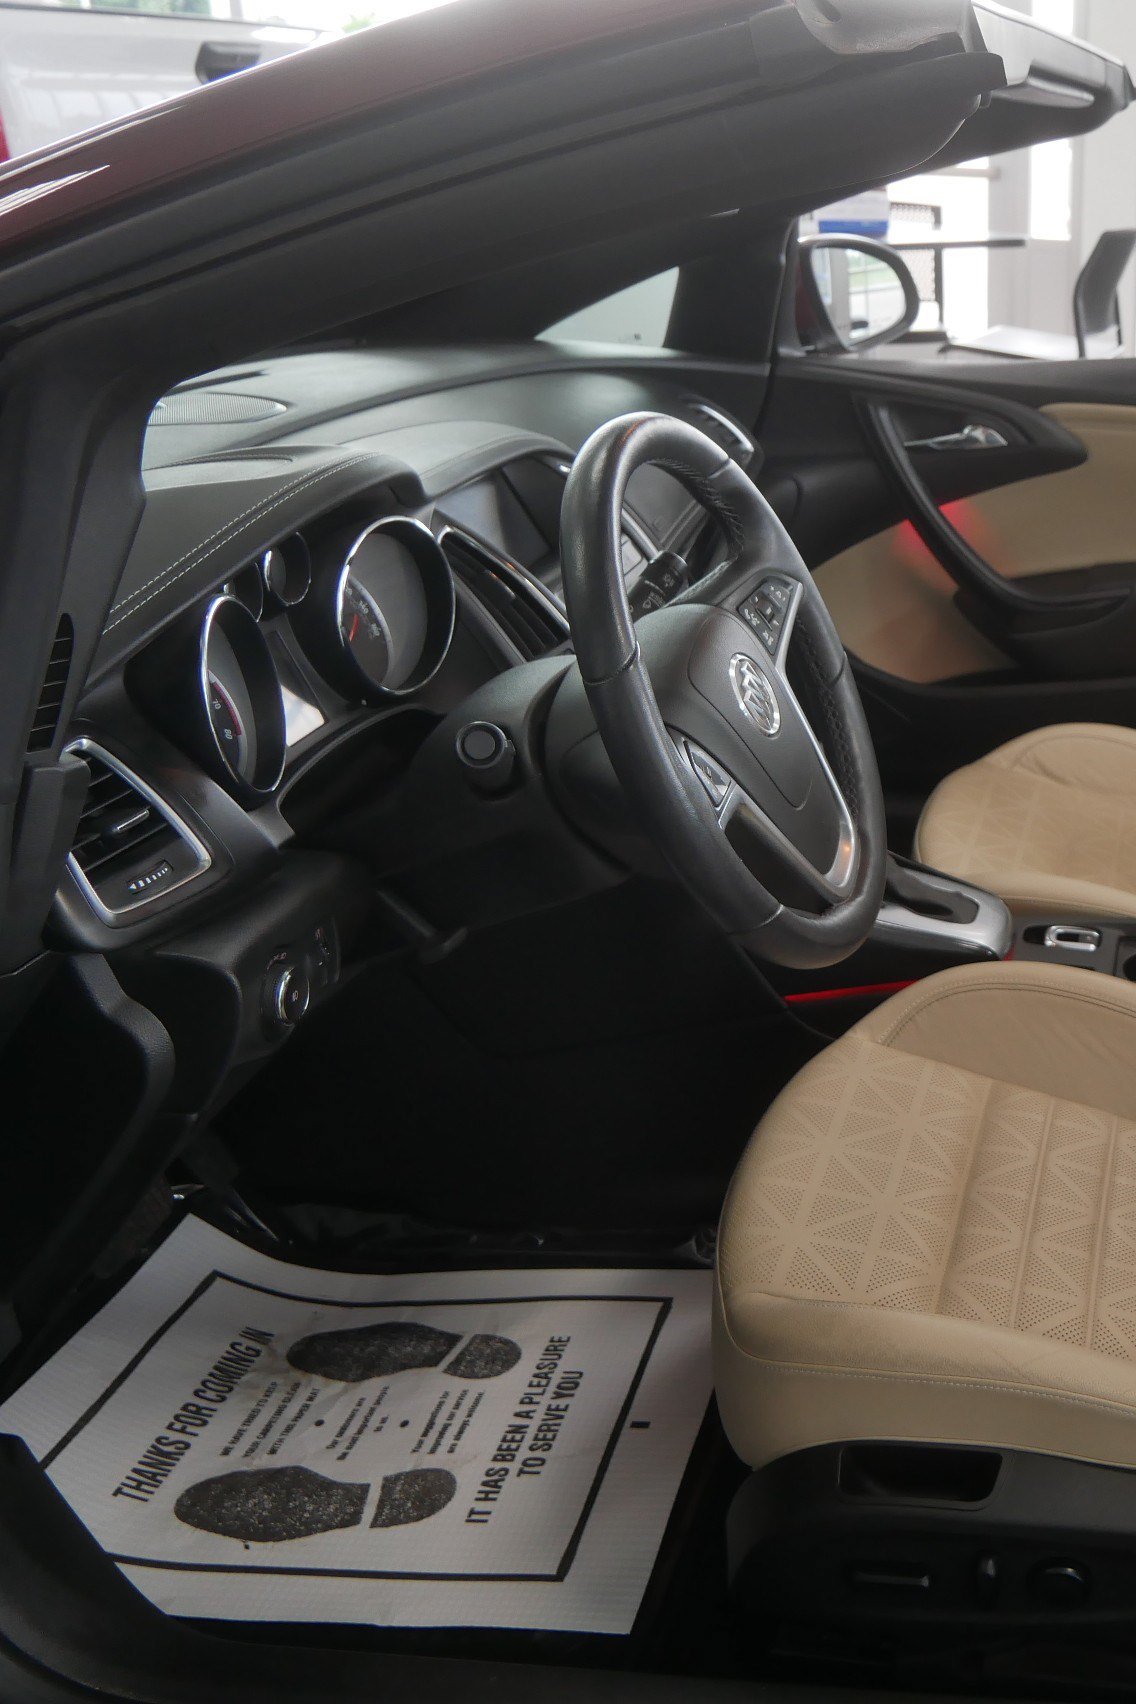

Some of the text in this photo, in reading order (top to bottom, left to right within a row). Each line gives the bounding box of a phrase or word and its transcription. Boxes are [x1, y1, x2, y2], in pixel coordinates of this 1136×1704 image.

[112, 1326, 275, 1502] THANKS FOR COMING IN
[465, 1336, 571, 1524] IT HAS BEEN A PLEASURE
[516, 1370, 584, 1477] TO SERVE YOU
